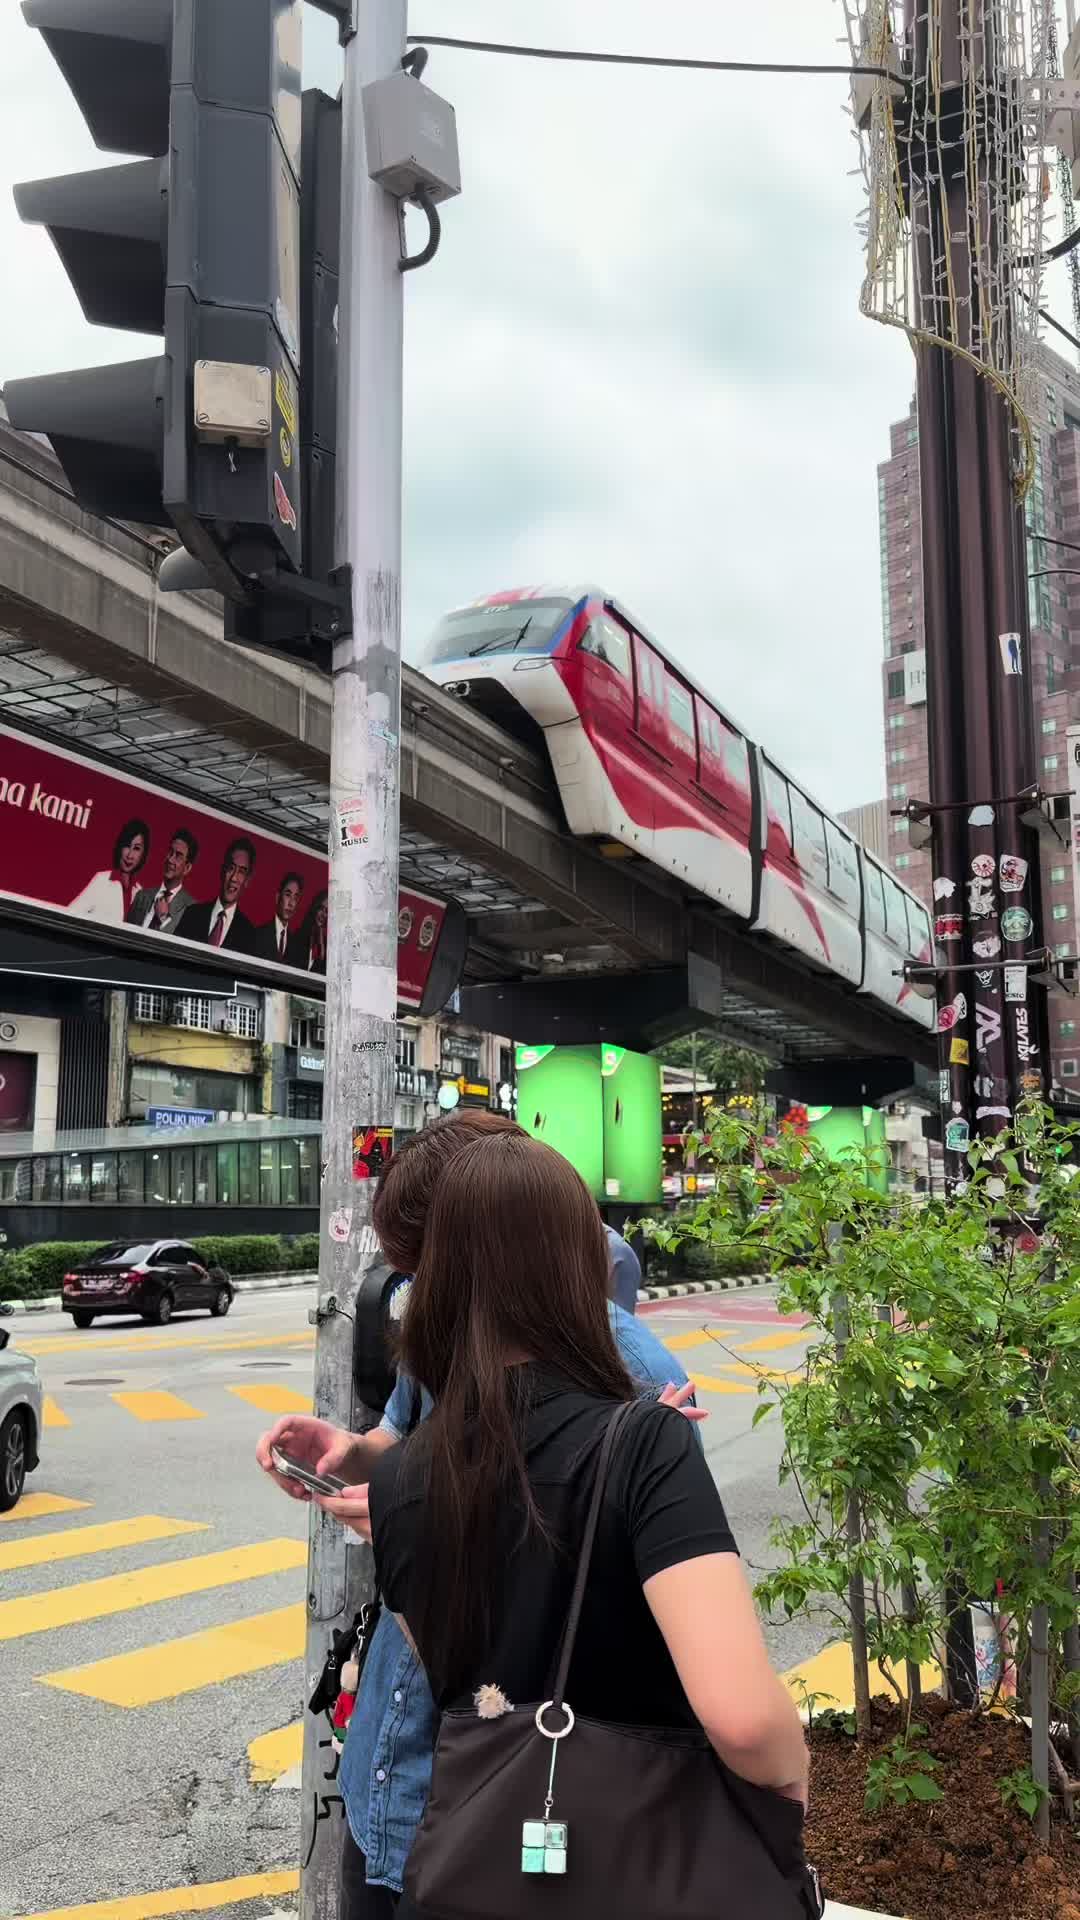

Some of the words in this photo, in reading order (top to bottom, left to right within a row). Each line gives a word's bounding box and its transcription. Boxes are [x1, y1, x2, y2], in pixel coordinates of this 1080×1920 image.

[28, 782, 94, 829] kami
[341, 827, 348, 840] I
[341, 837, 368, 846] MUSIC
[395, 1071, 427, 1096] ULAR
[156, 1112, 207, 1126] POLIKLINIK
